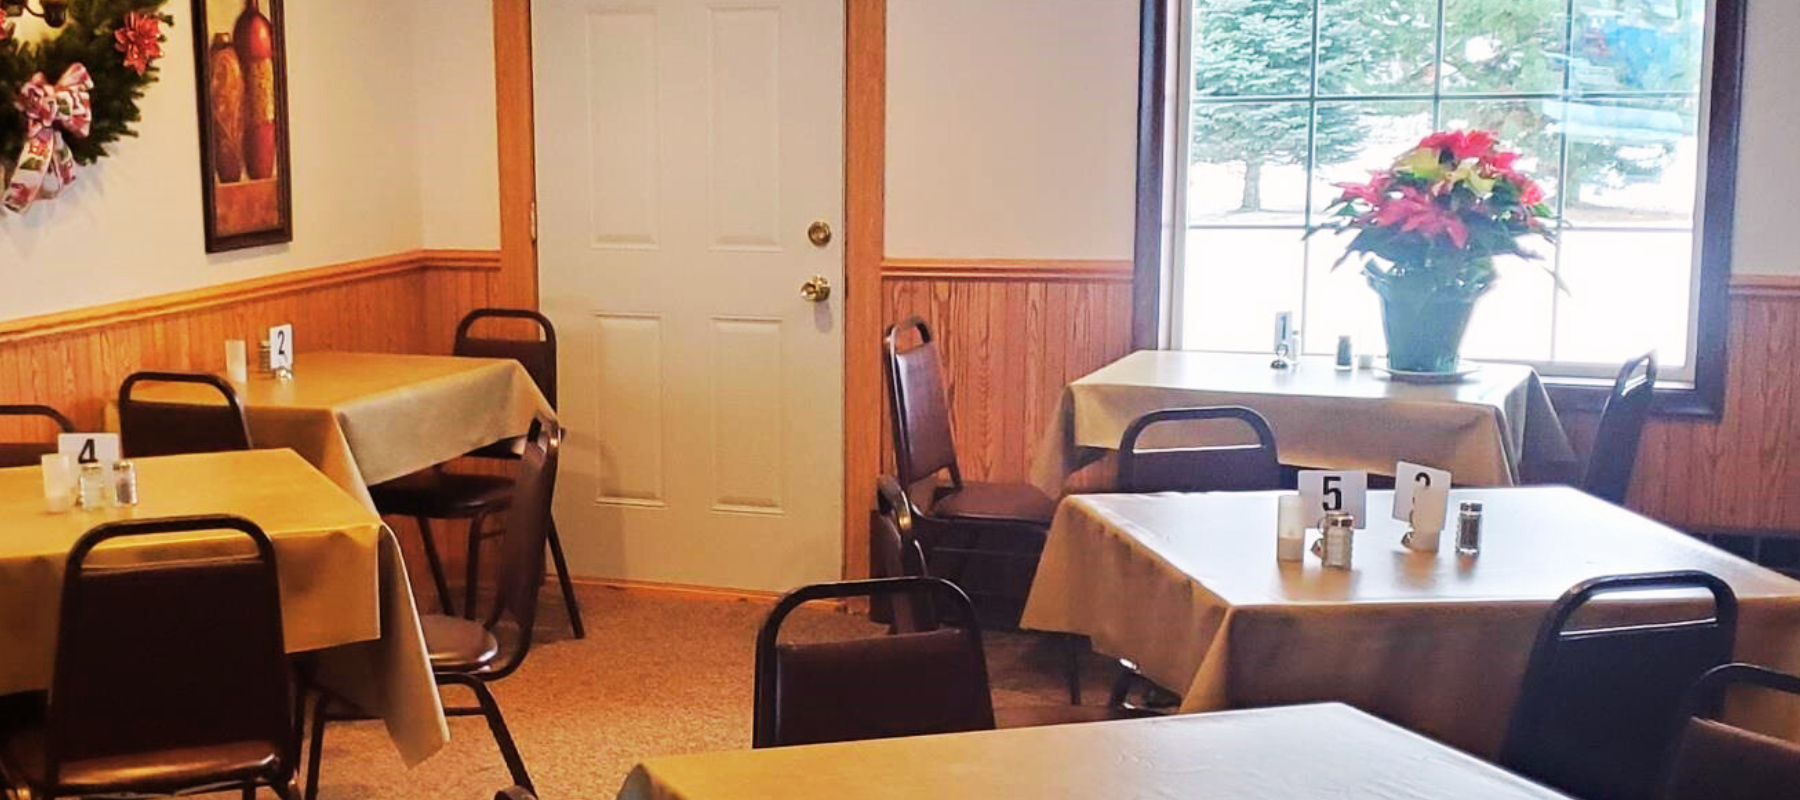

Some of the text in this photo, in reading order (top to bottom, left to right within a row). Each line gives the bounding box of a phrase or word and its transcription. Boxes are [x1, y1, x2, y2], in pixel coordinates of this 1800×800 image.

[1280, 314, 1287, 341] 1
[277, 330, 286, 355] 2
[78, 438, 99, 465] 4
[1322, 476, 1342, 512] 5
